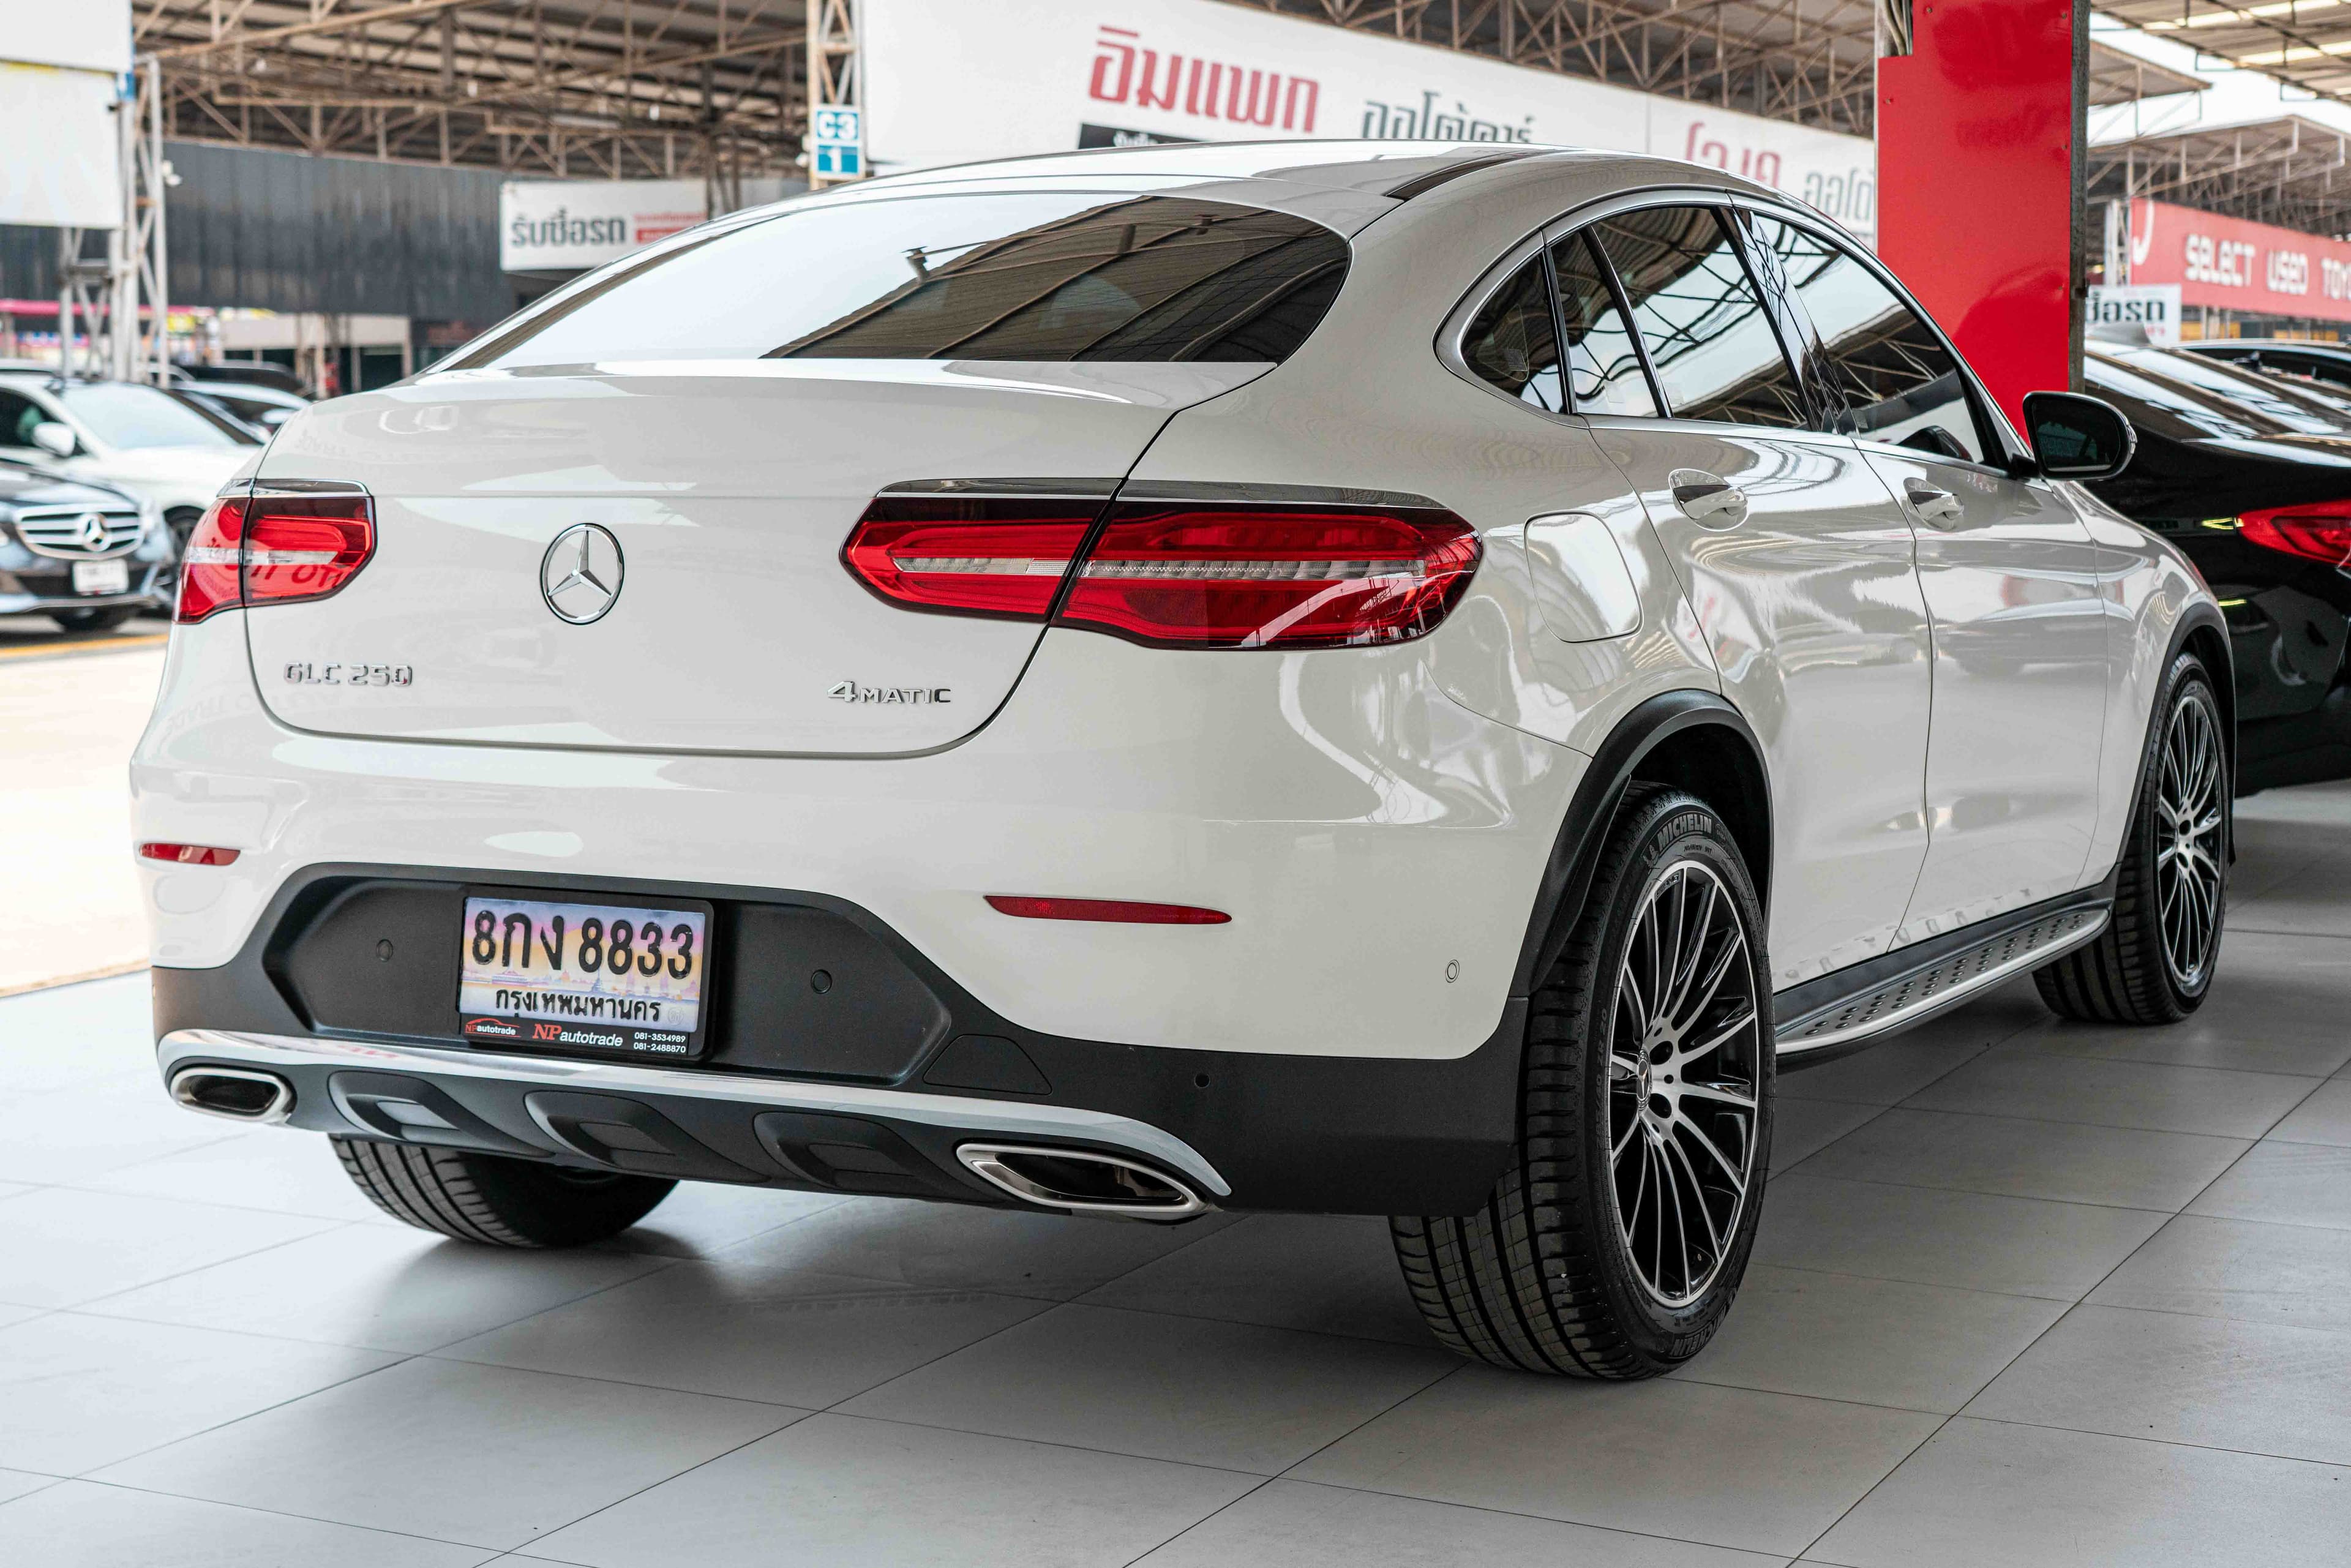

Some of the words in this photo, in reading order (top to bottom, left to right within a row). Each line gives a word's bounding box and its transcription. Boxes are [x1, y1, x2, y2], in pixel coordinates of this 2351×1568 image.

[819, 113, 857, 139] C3
[827, 147, 842, 173] 1
[283, 661, 342, 685] GLC
[347, 664, 413, 687] 250
[827, 680, 951, 704] 4MATIC
[1657, 813, 1712, 852] MICHELIN
[471, 909, 565, 971] 8กง
[578, 917, 694, 980] 8833
[495, 988, 661, 1022] กรุงเทพมหานคร
[634, 1032, 686, 1043] 081-3534989
[634, 1042, 686, 1053] 081-2488870
